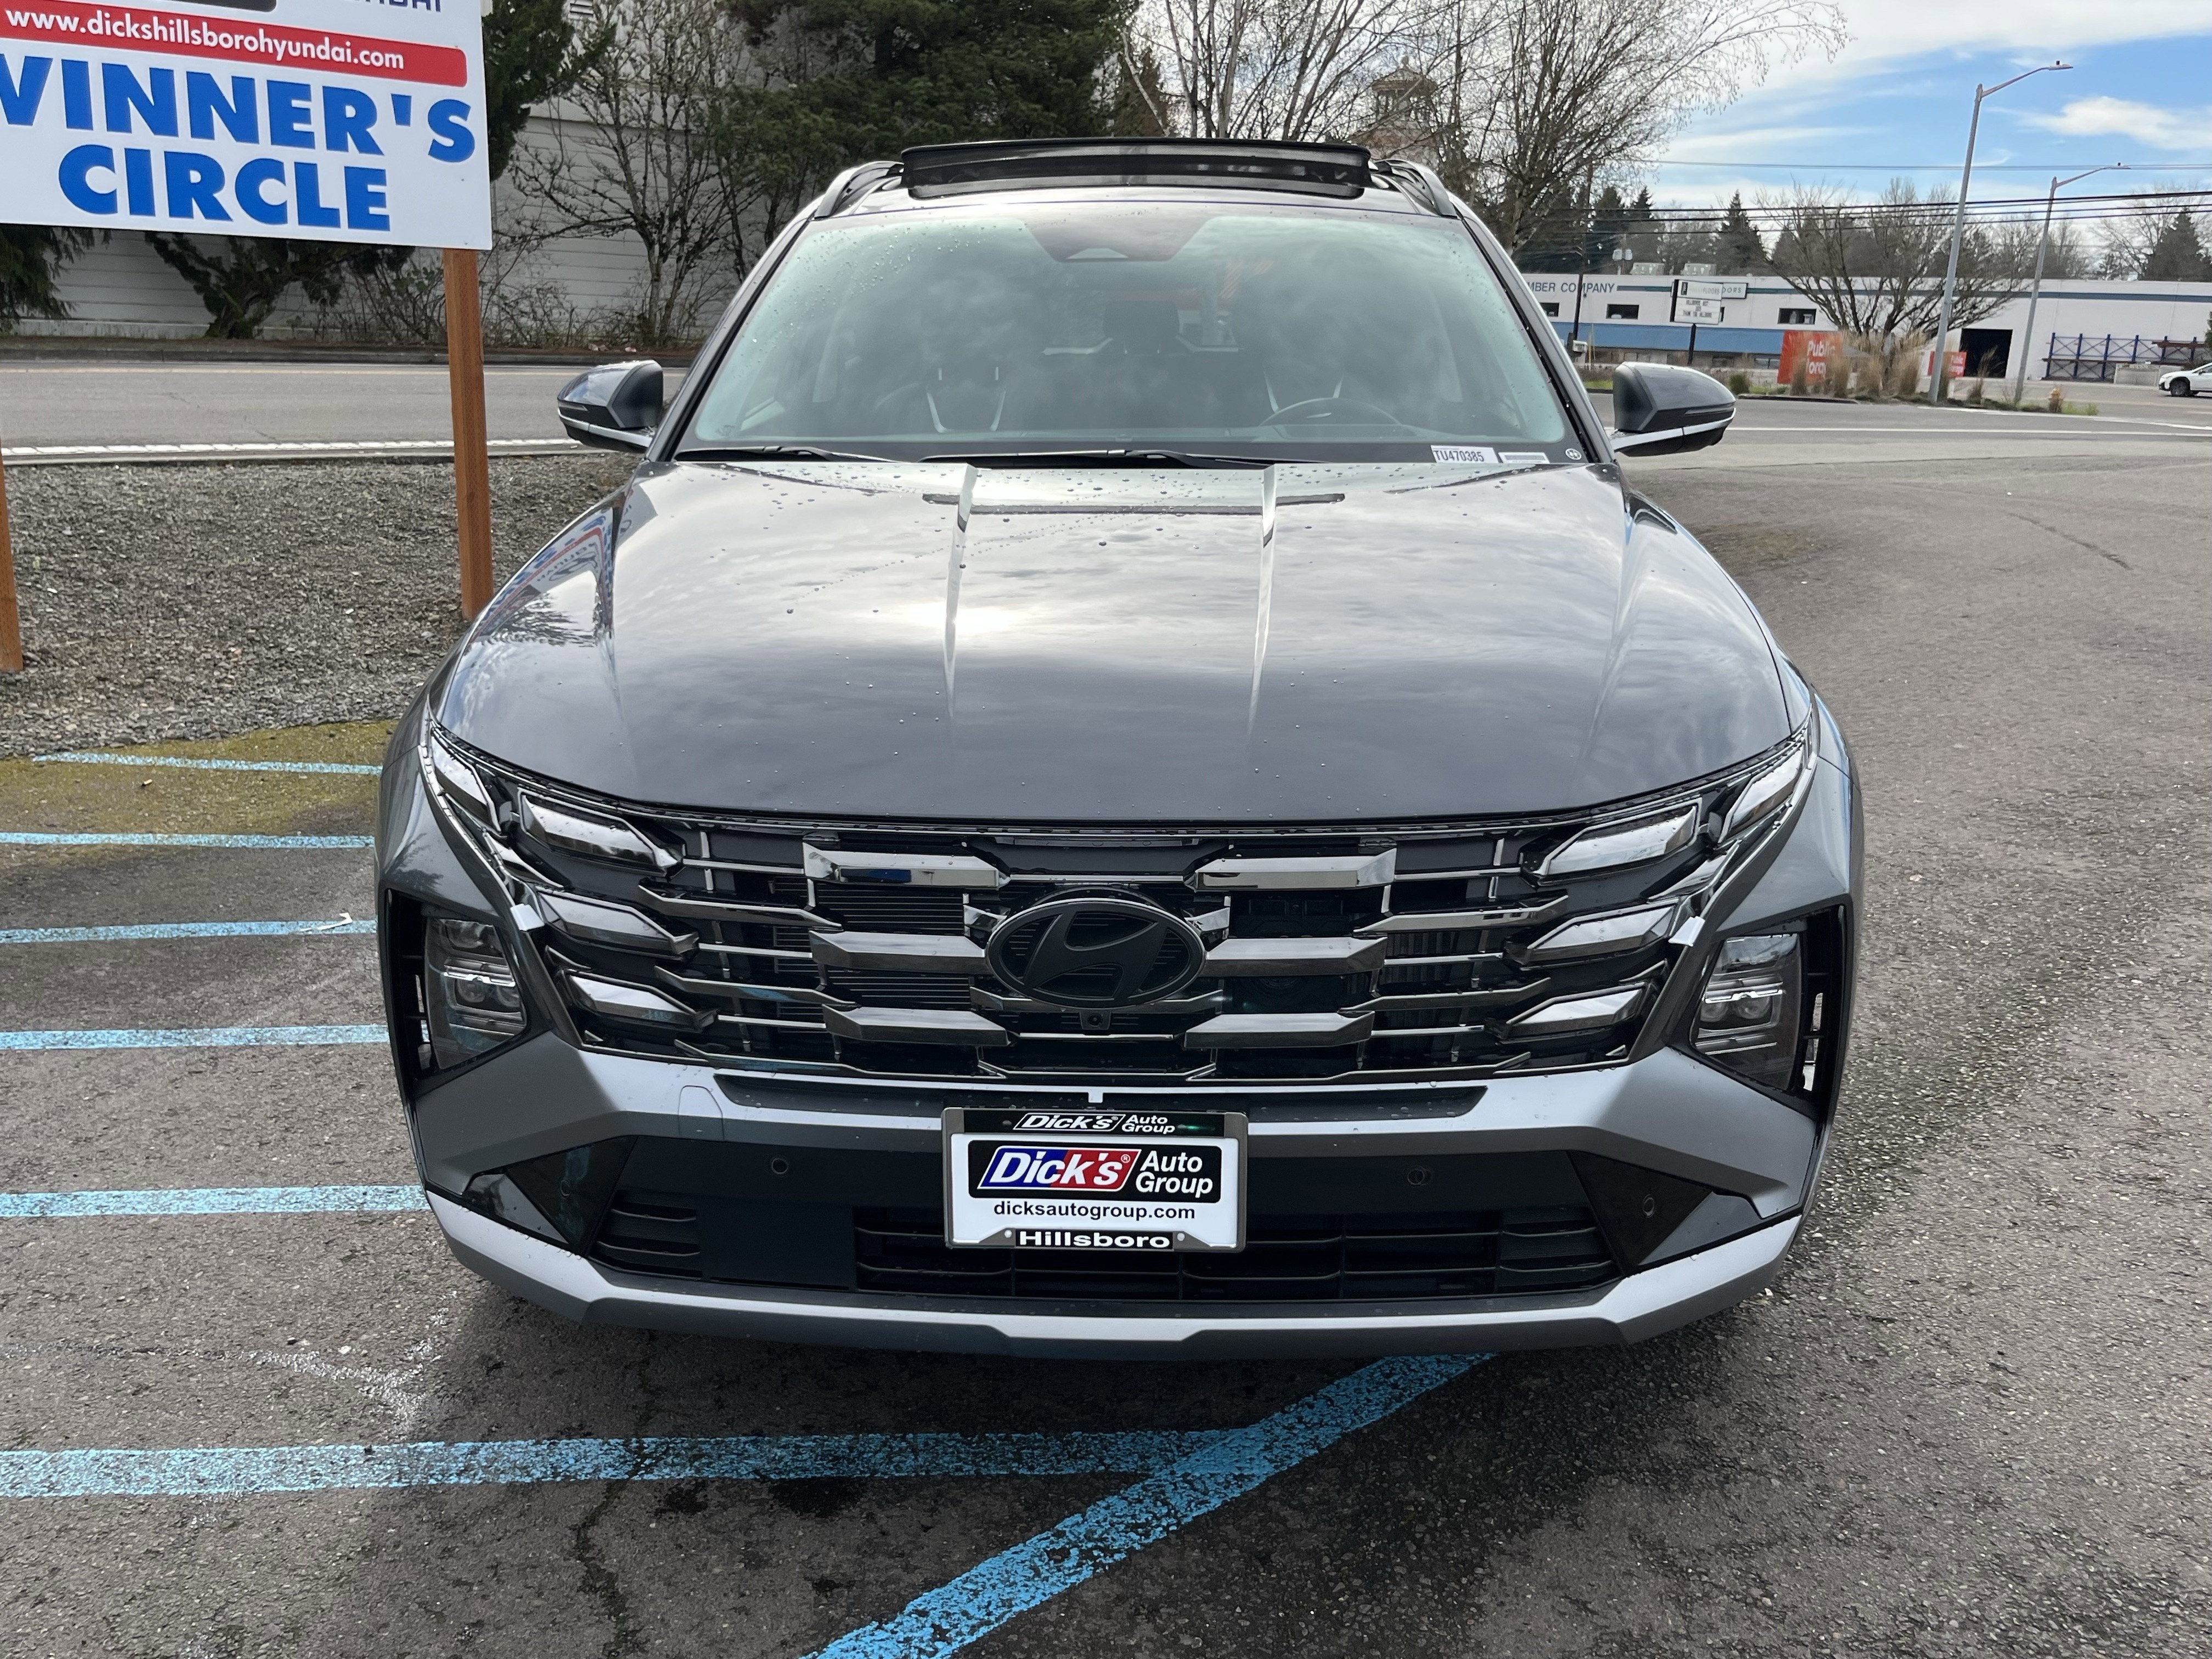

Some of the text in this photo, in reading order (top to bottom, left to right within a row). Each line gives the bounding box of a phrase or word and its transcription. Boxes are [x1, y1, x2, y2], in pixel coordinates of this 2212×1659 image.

[6, 9, 404, 70] www.dickshillsborohyundai.com
[58, 144, 391, 232] CIRCLE
[1433, 450, 1485, 462] TU470385
[1020, 1114, 1169, 1130] Dick's Auto
[1121, 1123, 1176, 1135] Group
[989, 1150, 1203, 1186] Dick's Auto
[1135, 1171, 1214, 1198] Group
[994, 1200, 1195, 1221] dicksautogroup.com
[1019, 1231, 1170, 1249] Hillsboro
